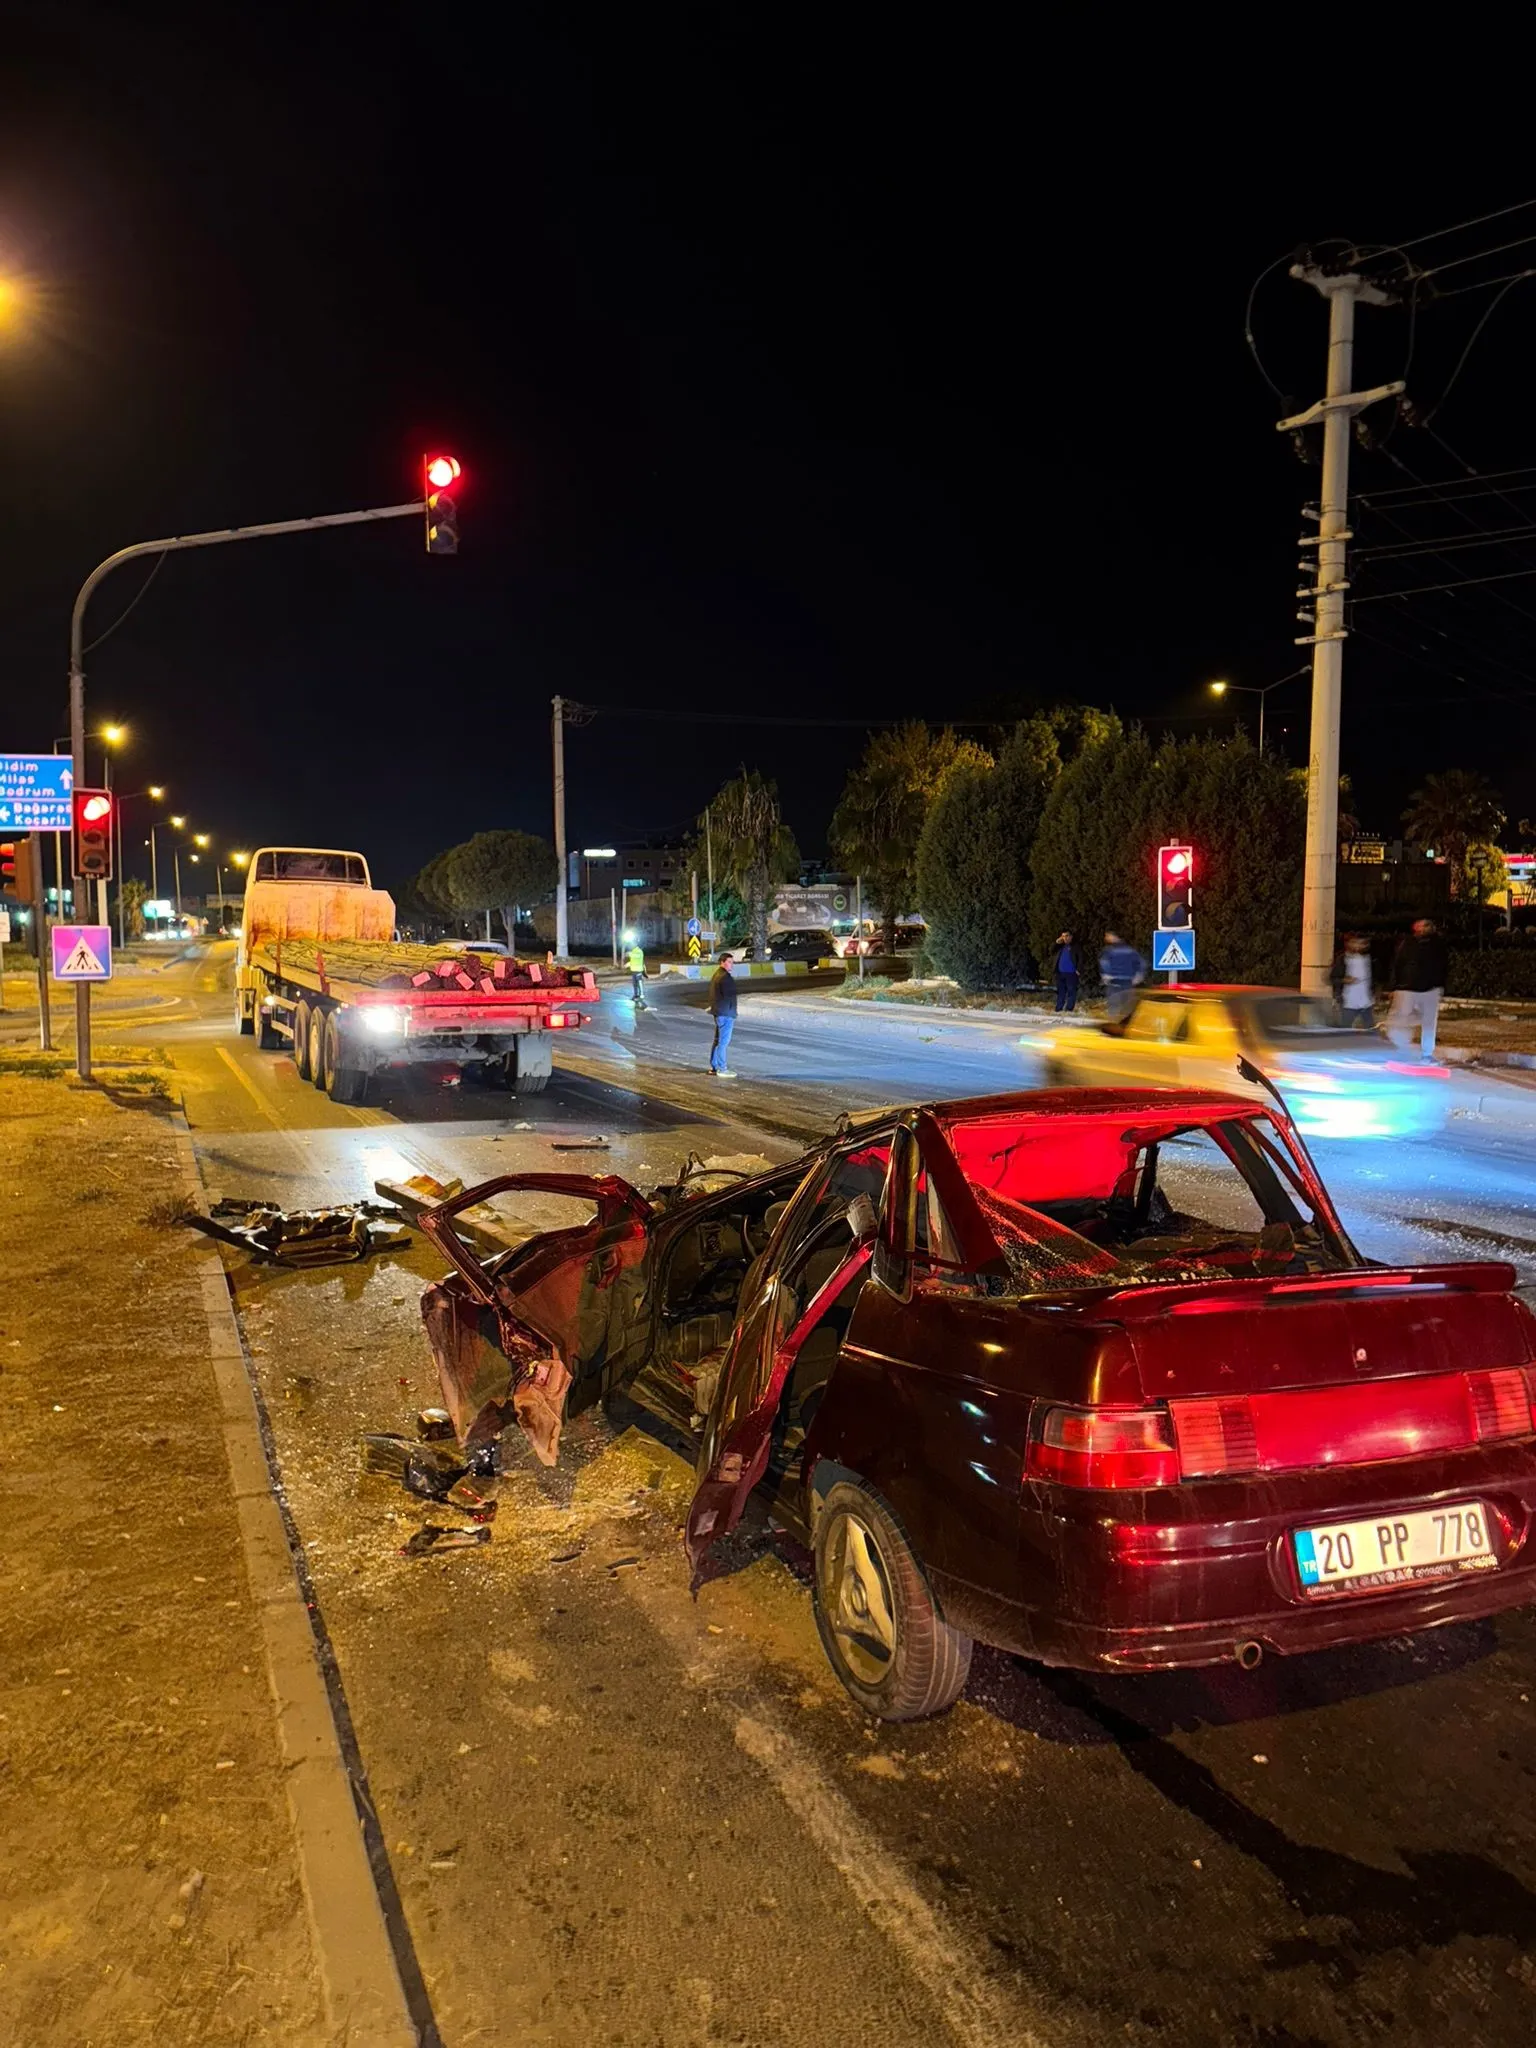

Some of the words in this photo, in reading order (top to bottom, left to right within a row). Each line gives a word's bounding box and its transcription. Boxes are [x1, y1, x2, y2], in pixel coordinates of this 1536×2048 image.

[1319, 1532, 1354, 1574] 20
[1376, 1522, 1409, 1565] PP
[1432, 1511, 1484, 1556] 778
[1302, 1559, 1317, 1574] TR
